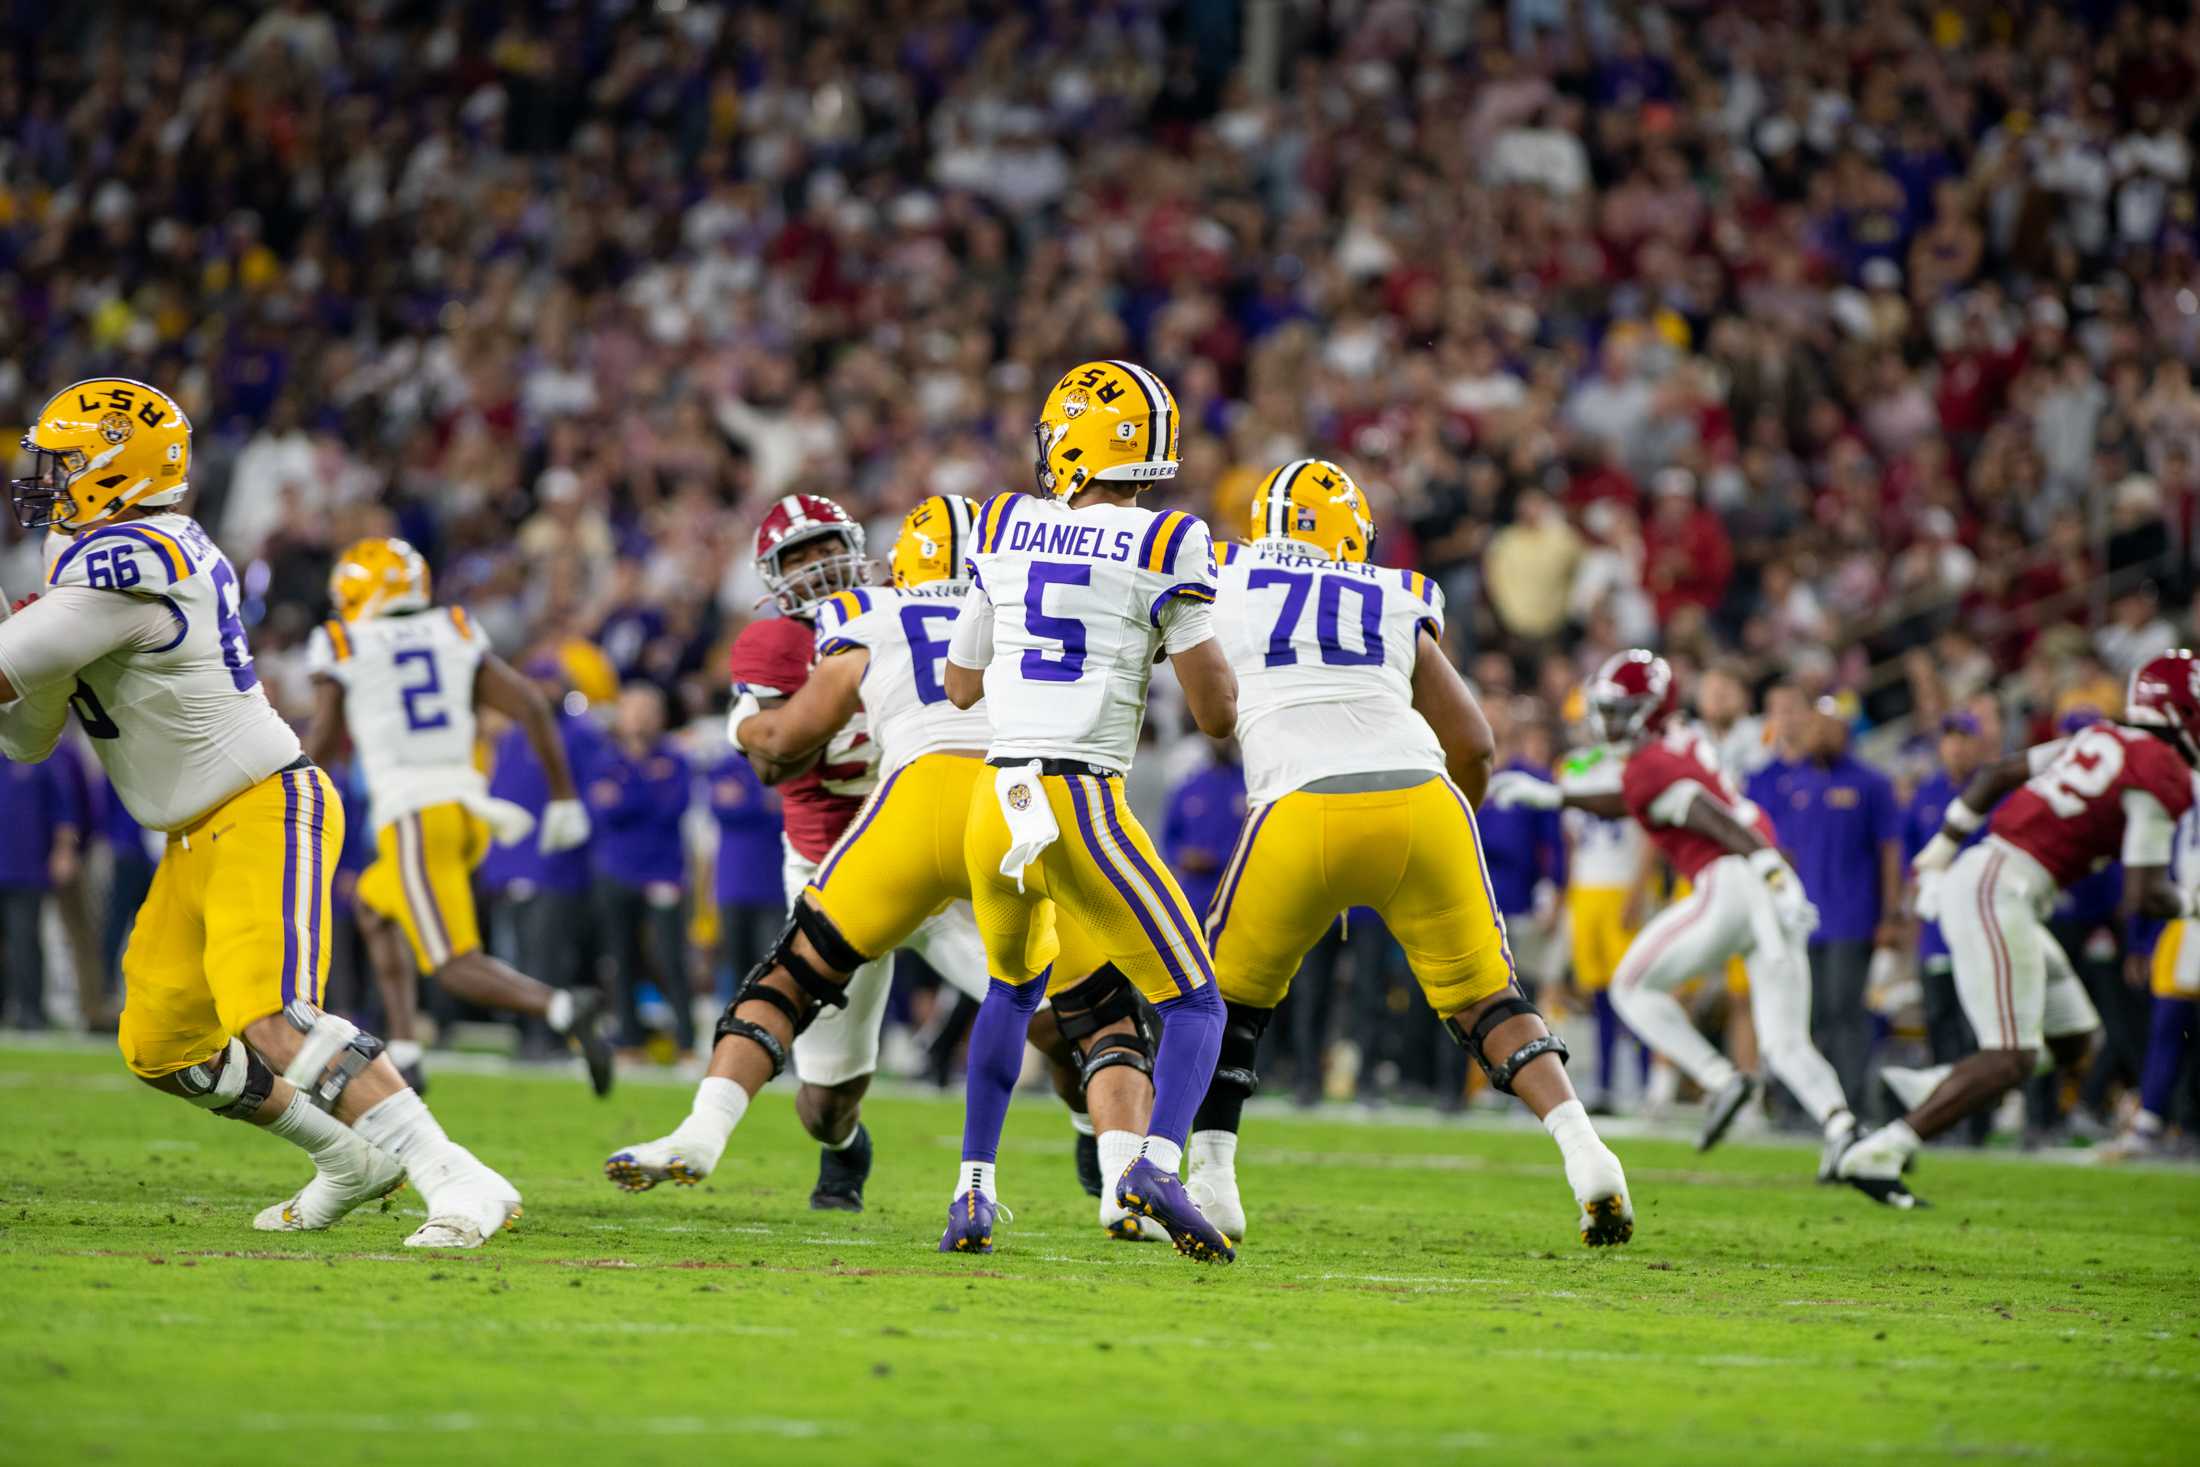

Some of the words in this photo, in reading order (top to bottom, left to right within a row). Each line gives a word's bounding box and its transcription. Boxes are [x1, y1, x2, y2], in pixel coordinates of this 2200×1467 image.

[1122, 424, 1131, 437] 3
[86, 544, 141, 590] 66
[1010, 521, 1133, 562] DANIELS
[1020, 560, 1092, 682] 5
[1247, 568, 1385, 668] 70
[393, 648, 449, 731] 2
